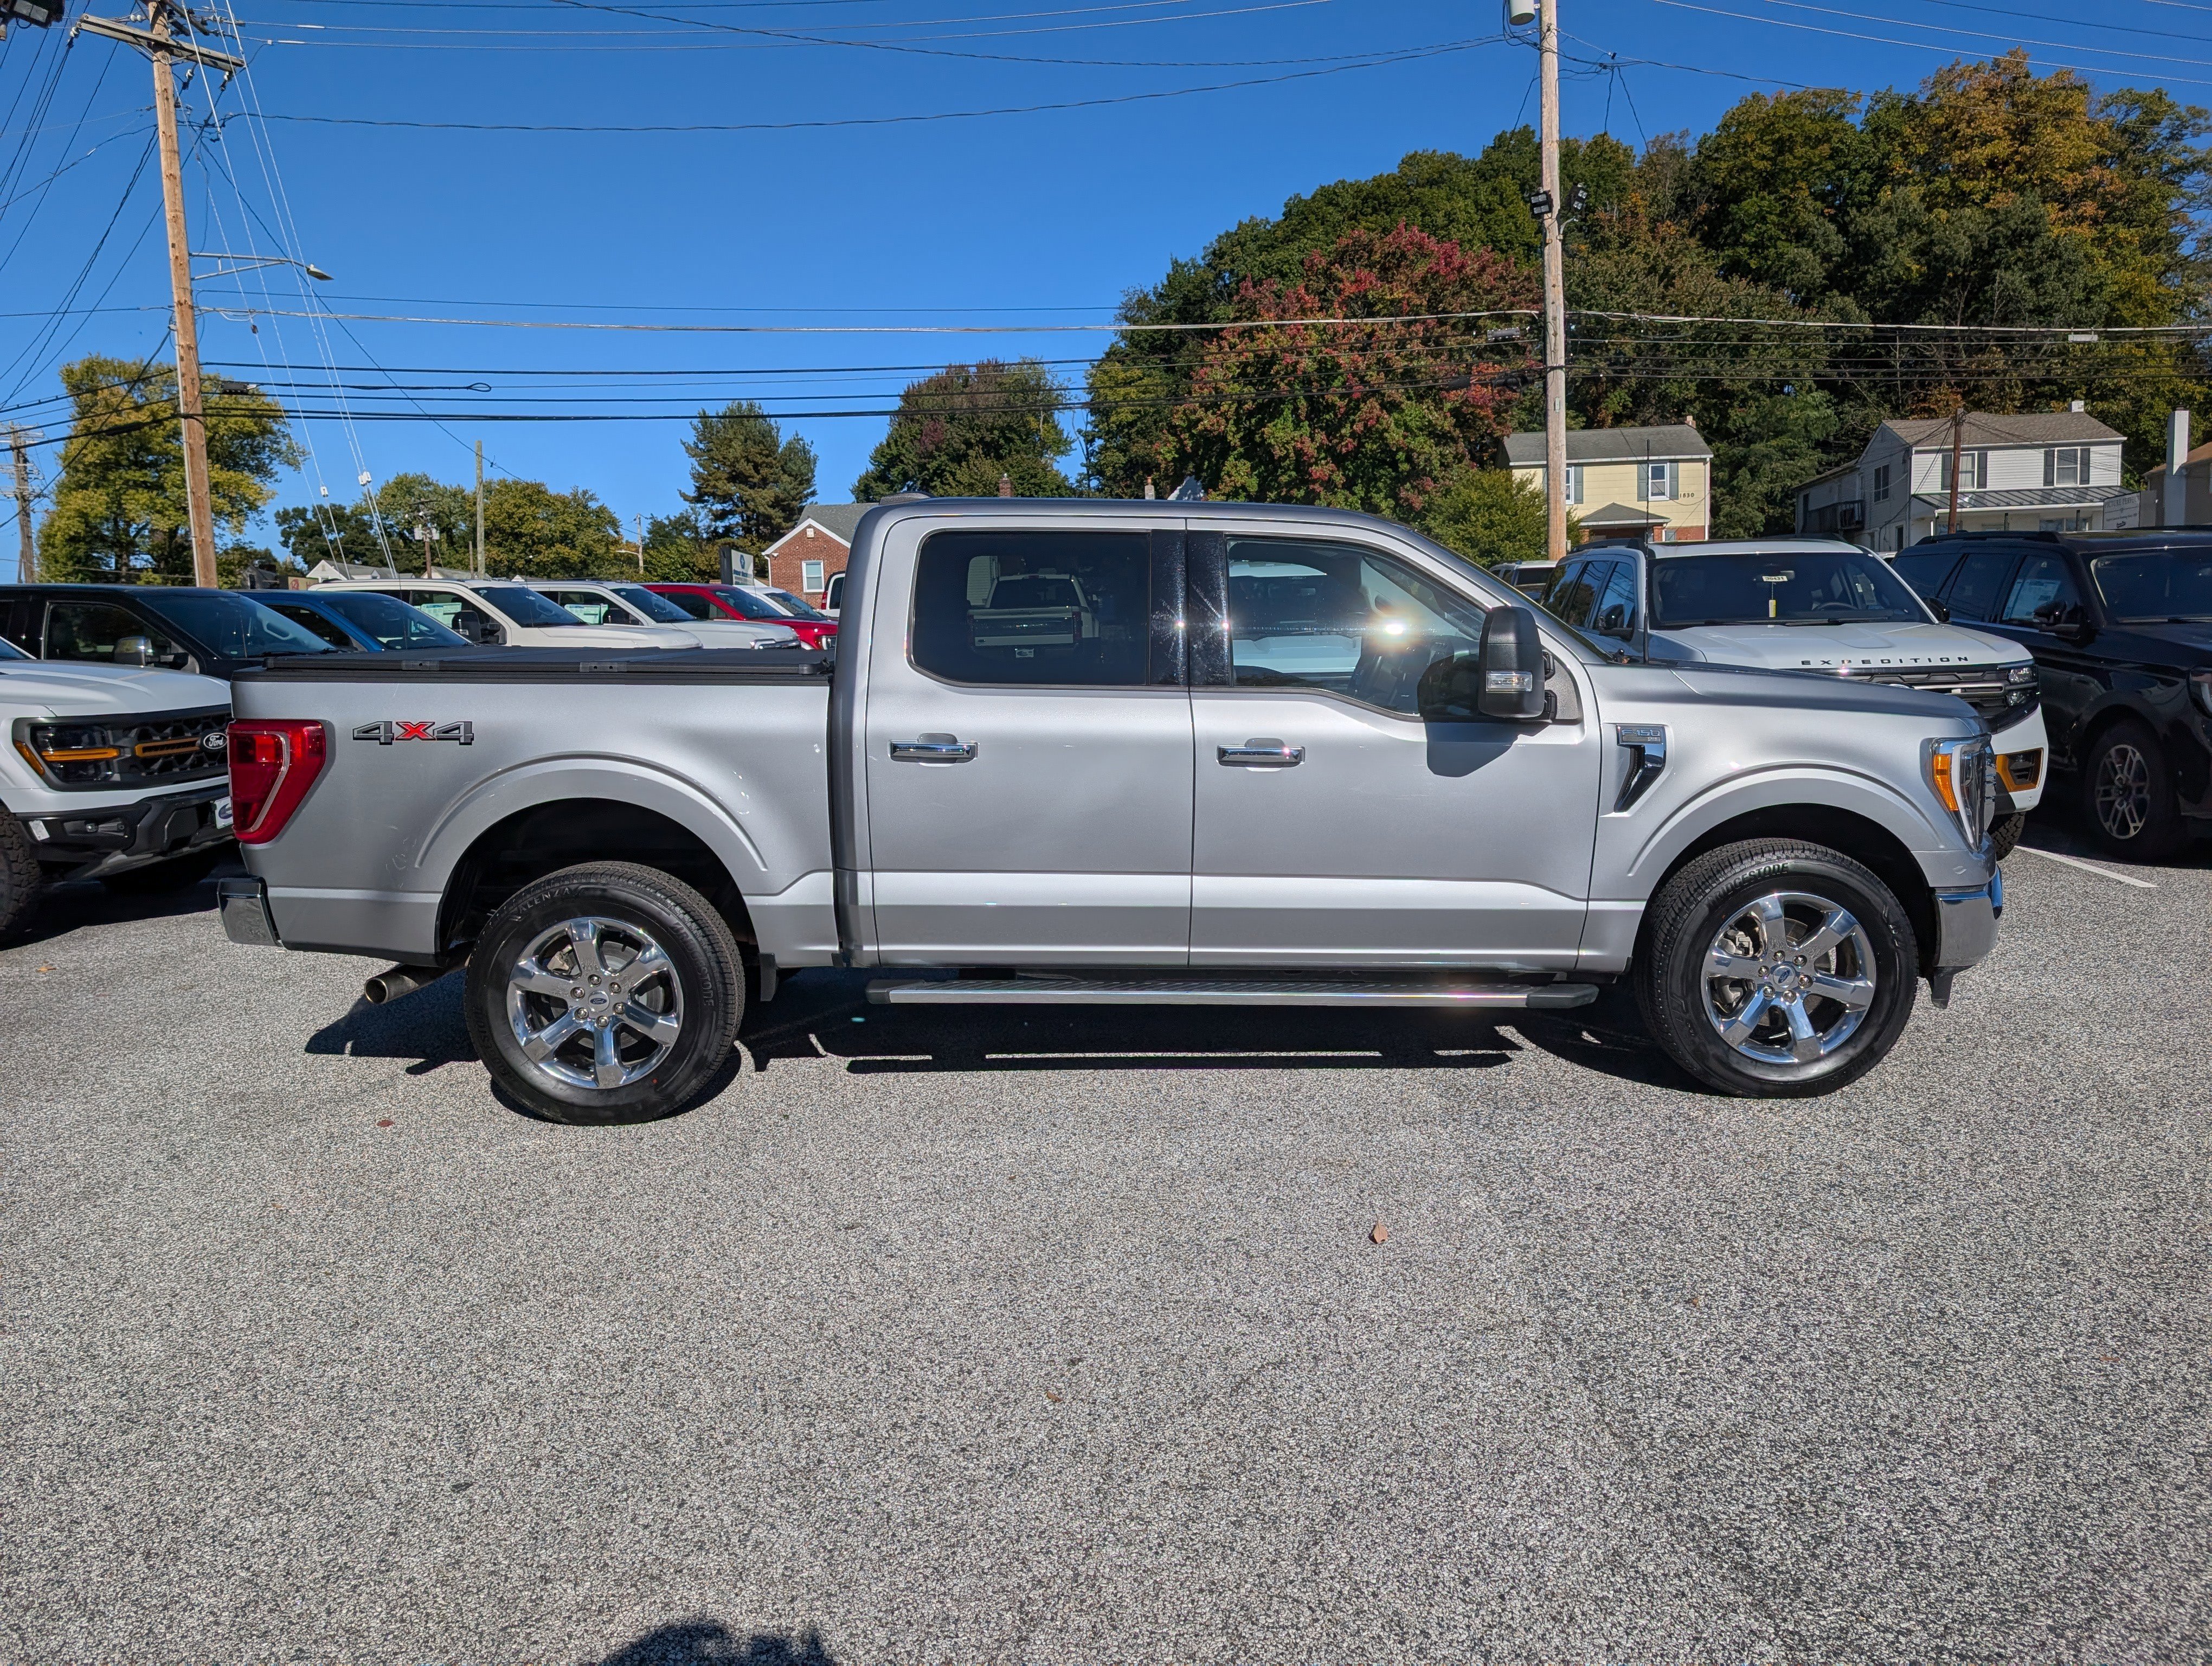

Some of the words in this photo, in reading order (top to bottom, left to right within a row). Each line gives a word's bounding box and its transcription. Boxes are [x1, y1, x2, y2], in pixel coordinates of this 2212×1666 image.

[1801, 656, 1969, 665] EXPEDITION
[1622, 728, 1661, 736] F-150
[209, 735, 224, 747] Ford
